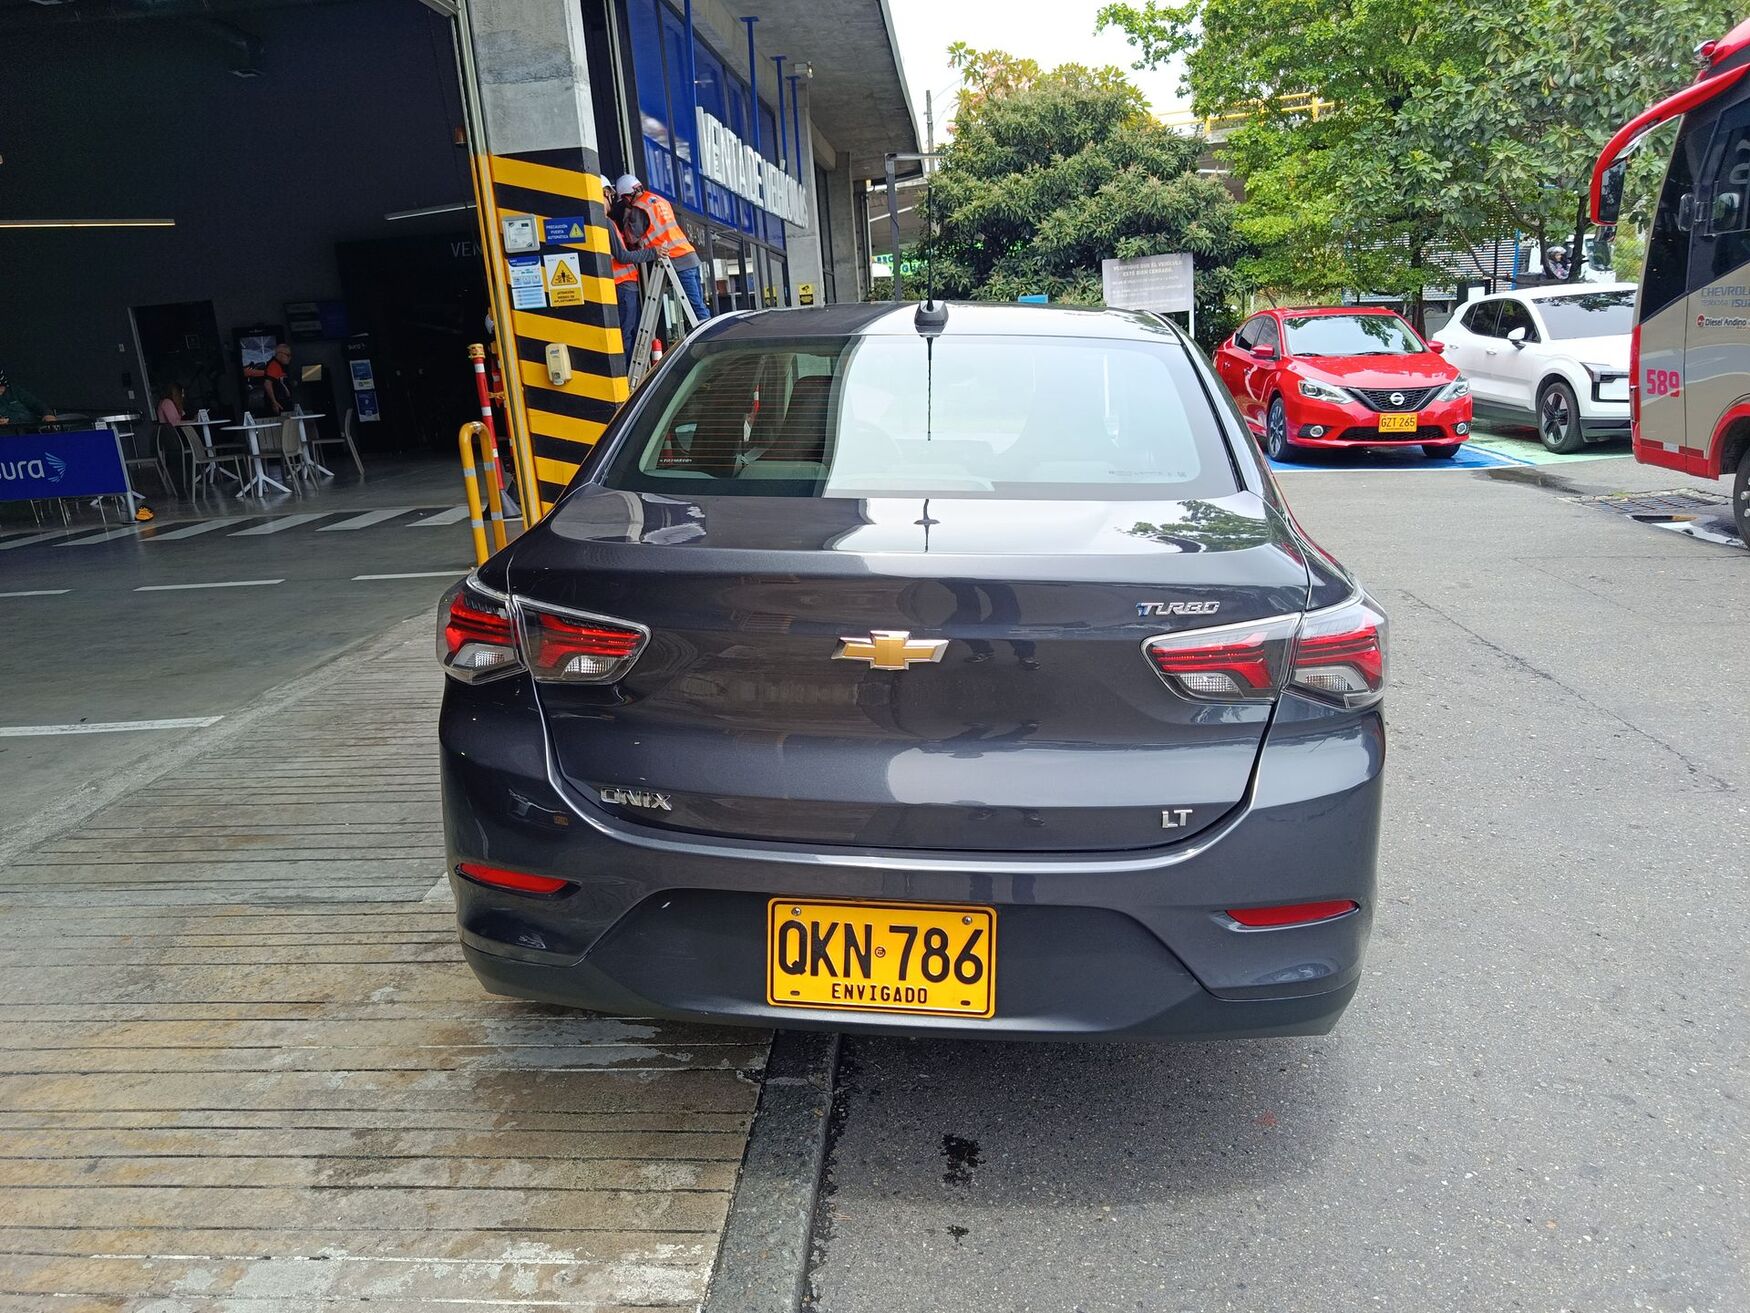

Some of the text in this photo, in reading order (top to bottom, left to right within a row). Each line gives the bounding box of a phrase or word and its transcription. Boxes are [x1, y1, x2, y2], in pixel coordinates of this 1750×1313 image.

[696, 106, 749, 200] VENTA
[1701, 286, 1750, 297] CHEVROL
[1705, 318, 1747, 327] Diesel Andino
[1646, 369, 1680, 398] 589
[1381, 417, 1415, 427] GZT 265
[0, 459, 46, 481] ura
[1136, 601, 1220, 617] TURBO
[600, 787, 673, 811] ONIX
[1162, 809, 1193, 829] LT
[778, 919, 984, 985] QKN 786
[831, 983, 928, 1004] ENVIGADO
